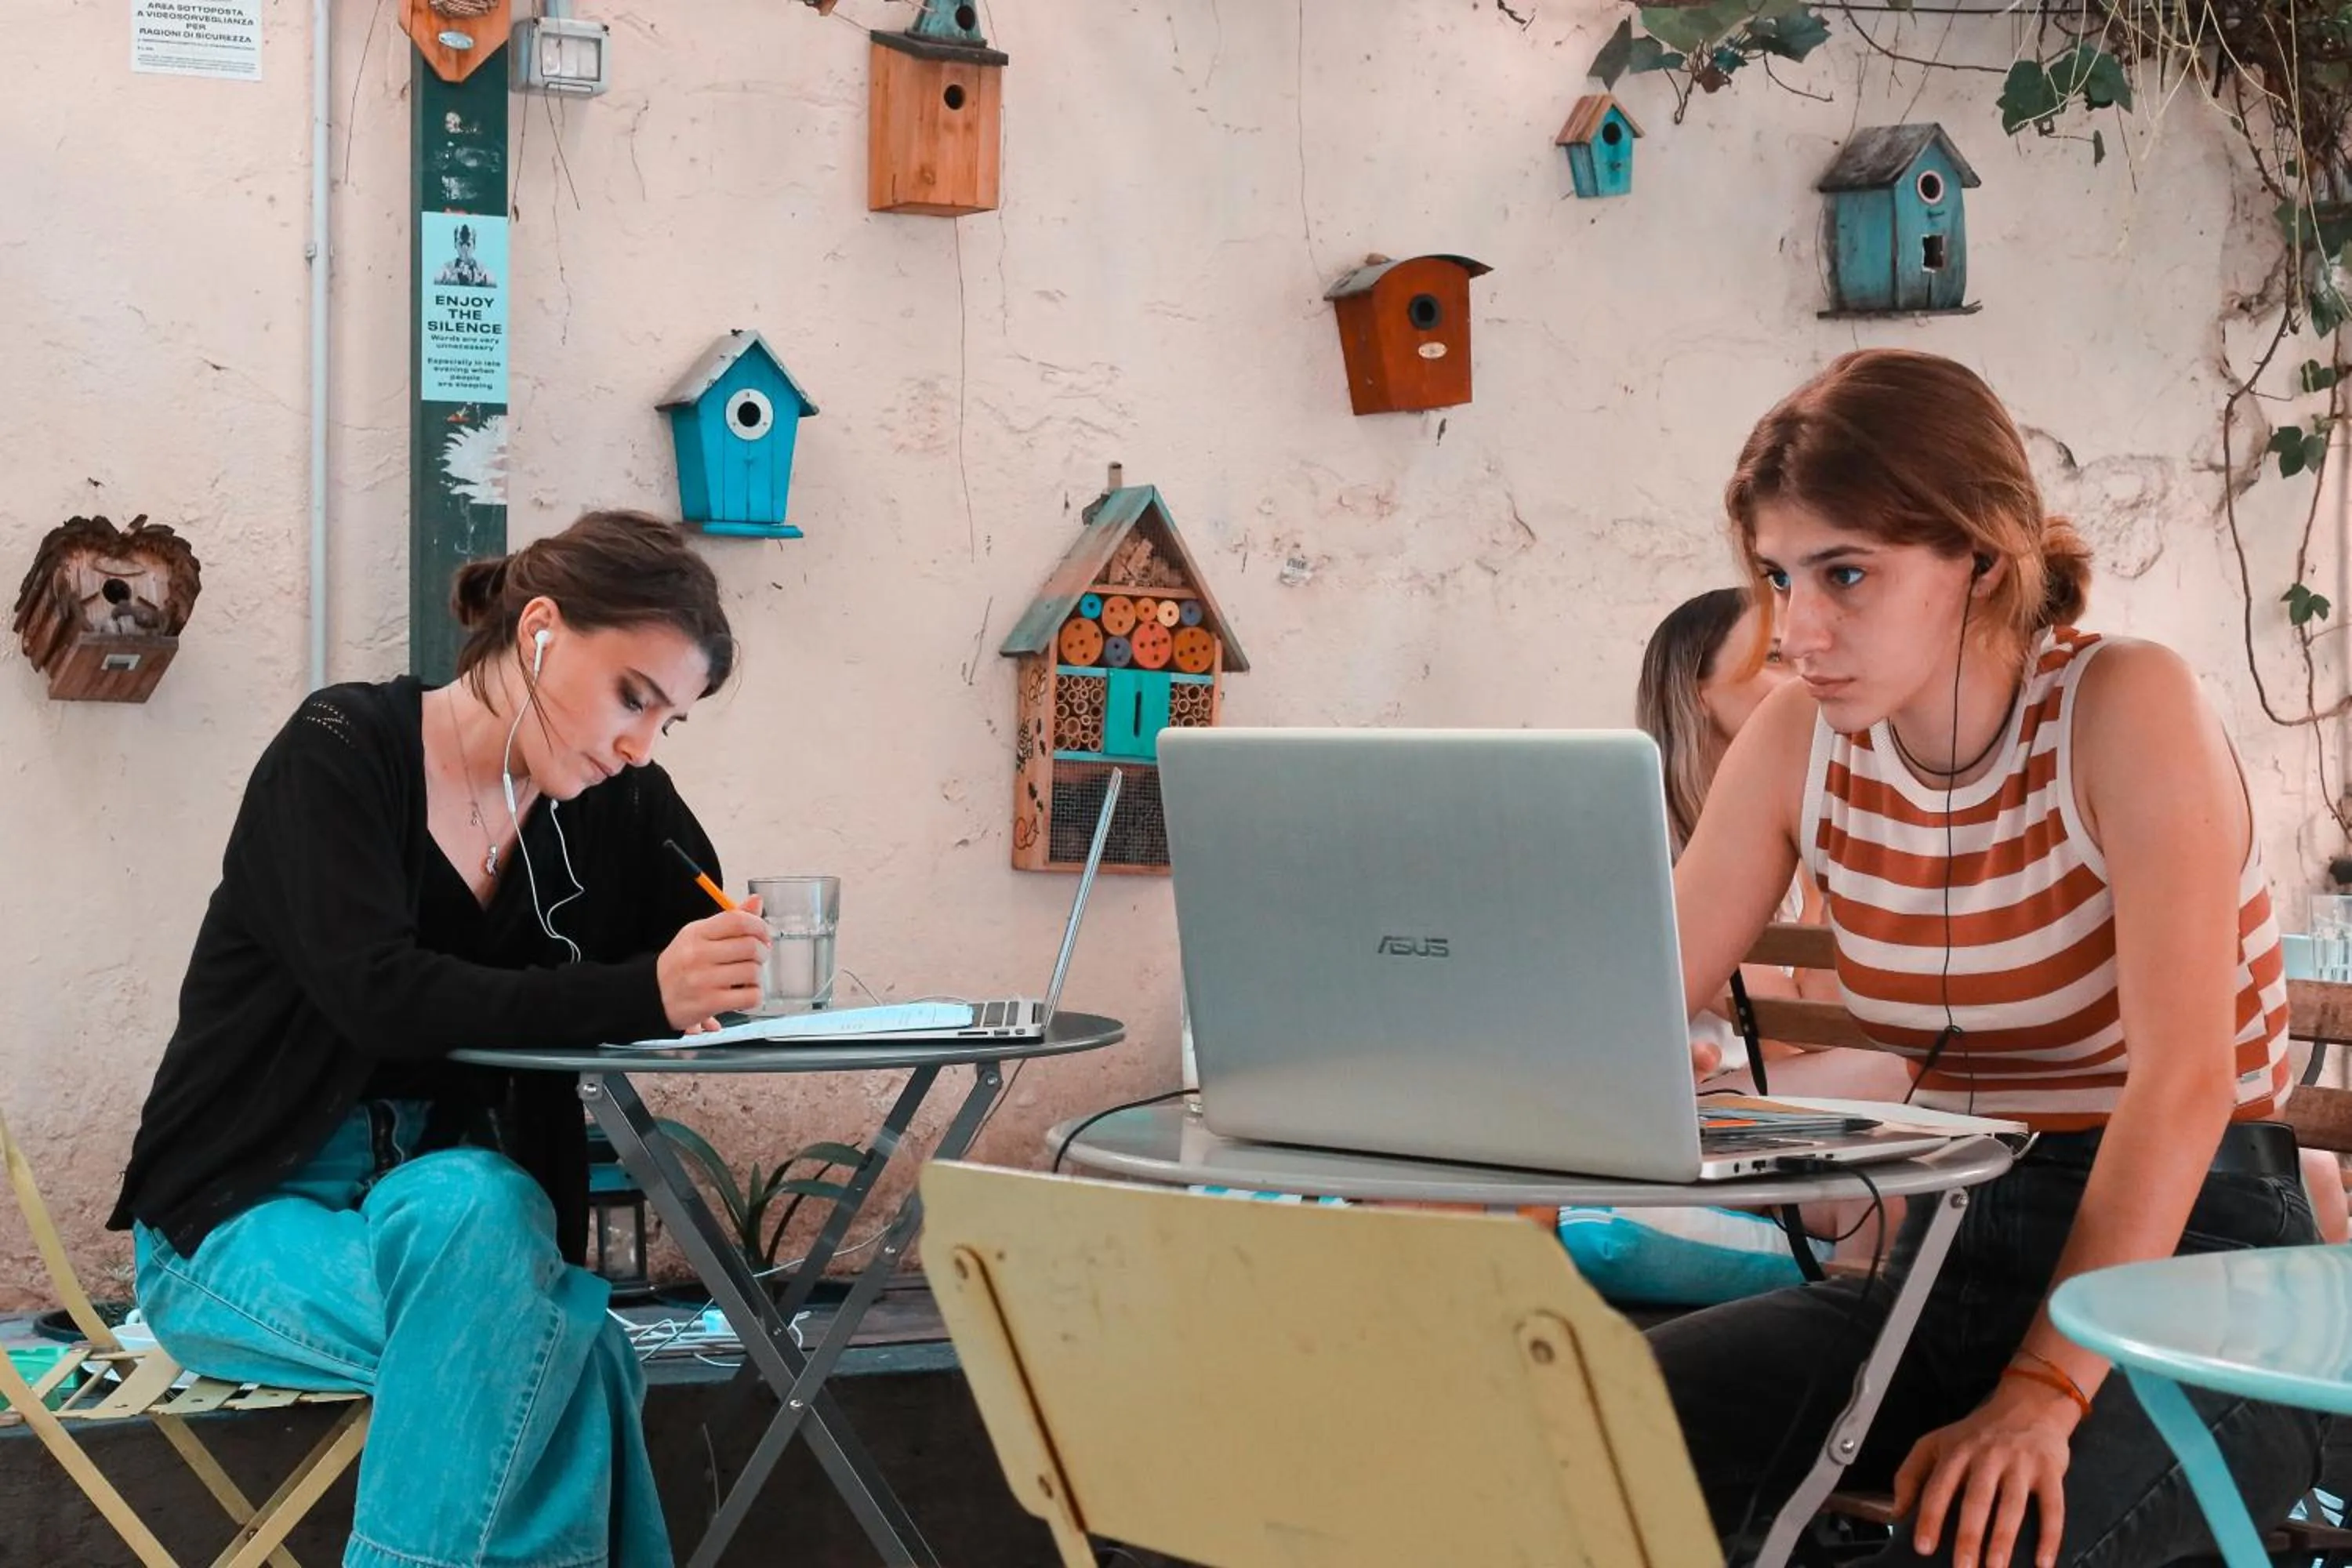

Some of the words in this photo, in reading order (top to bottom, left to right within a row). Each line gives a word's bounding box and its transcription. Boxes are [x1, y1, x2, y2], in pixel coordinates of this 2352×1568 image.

[177, 4, 244, 16] SOTTOPOSTA
[147, 11, 255, 26] VIDEOSORVEGLIANZA
[140, 28, 180, 38] RAGIONI
[196, 32, 252, 42] SICUREZZA
[435, 295, 495, 308] ENJOY
[448, 309, 482, 320] THE
[427, 321, 503, 334] SILENCE
[1377, 935, 1449, 957] ASUS
